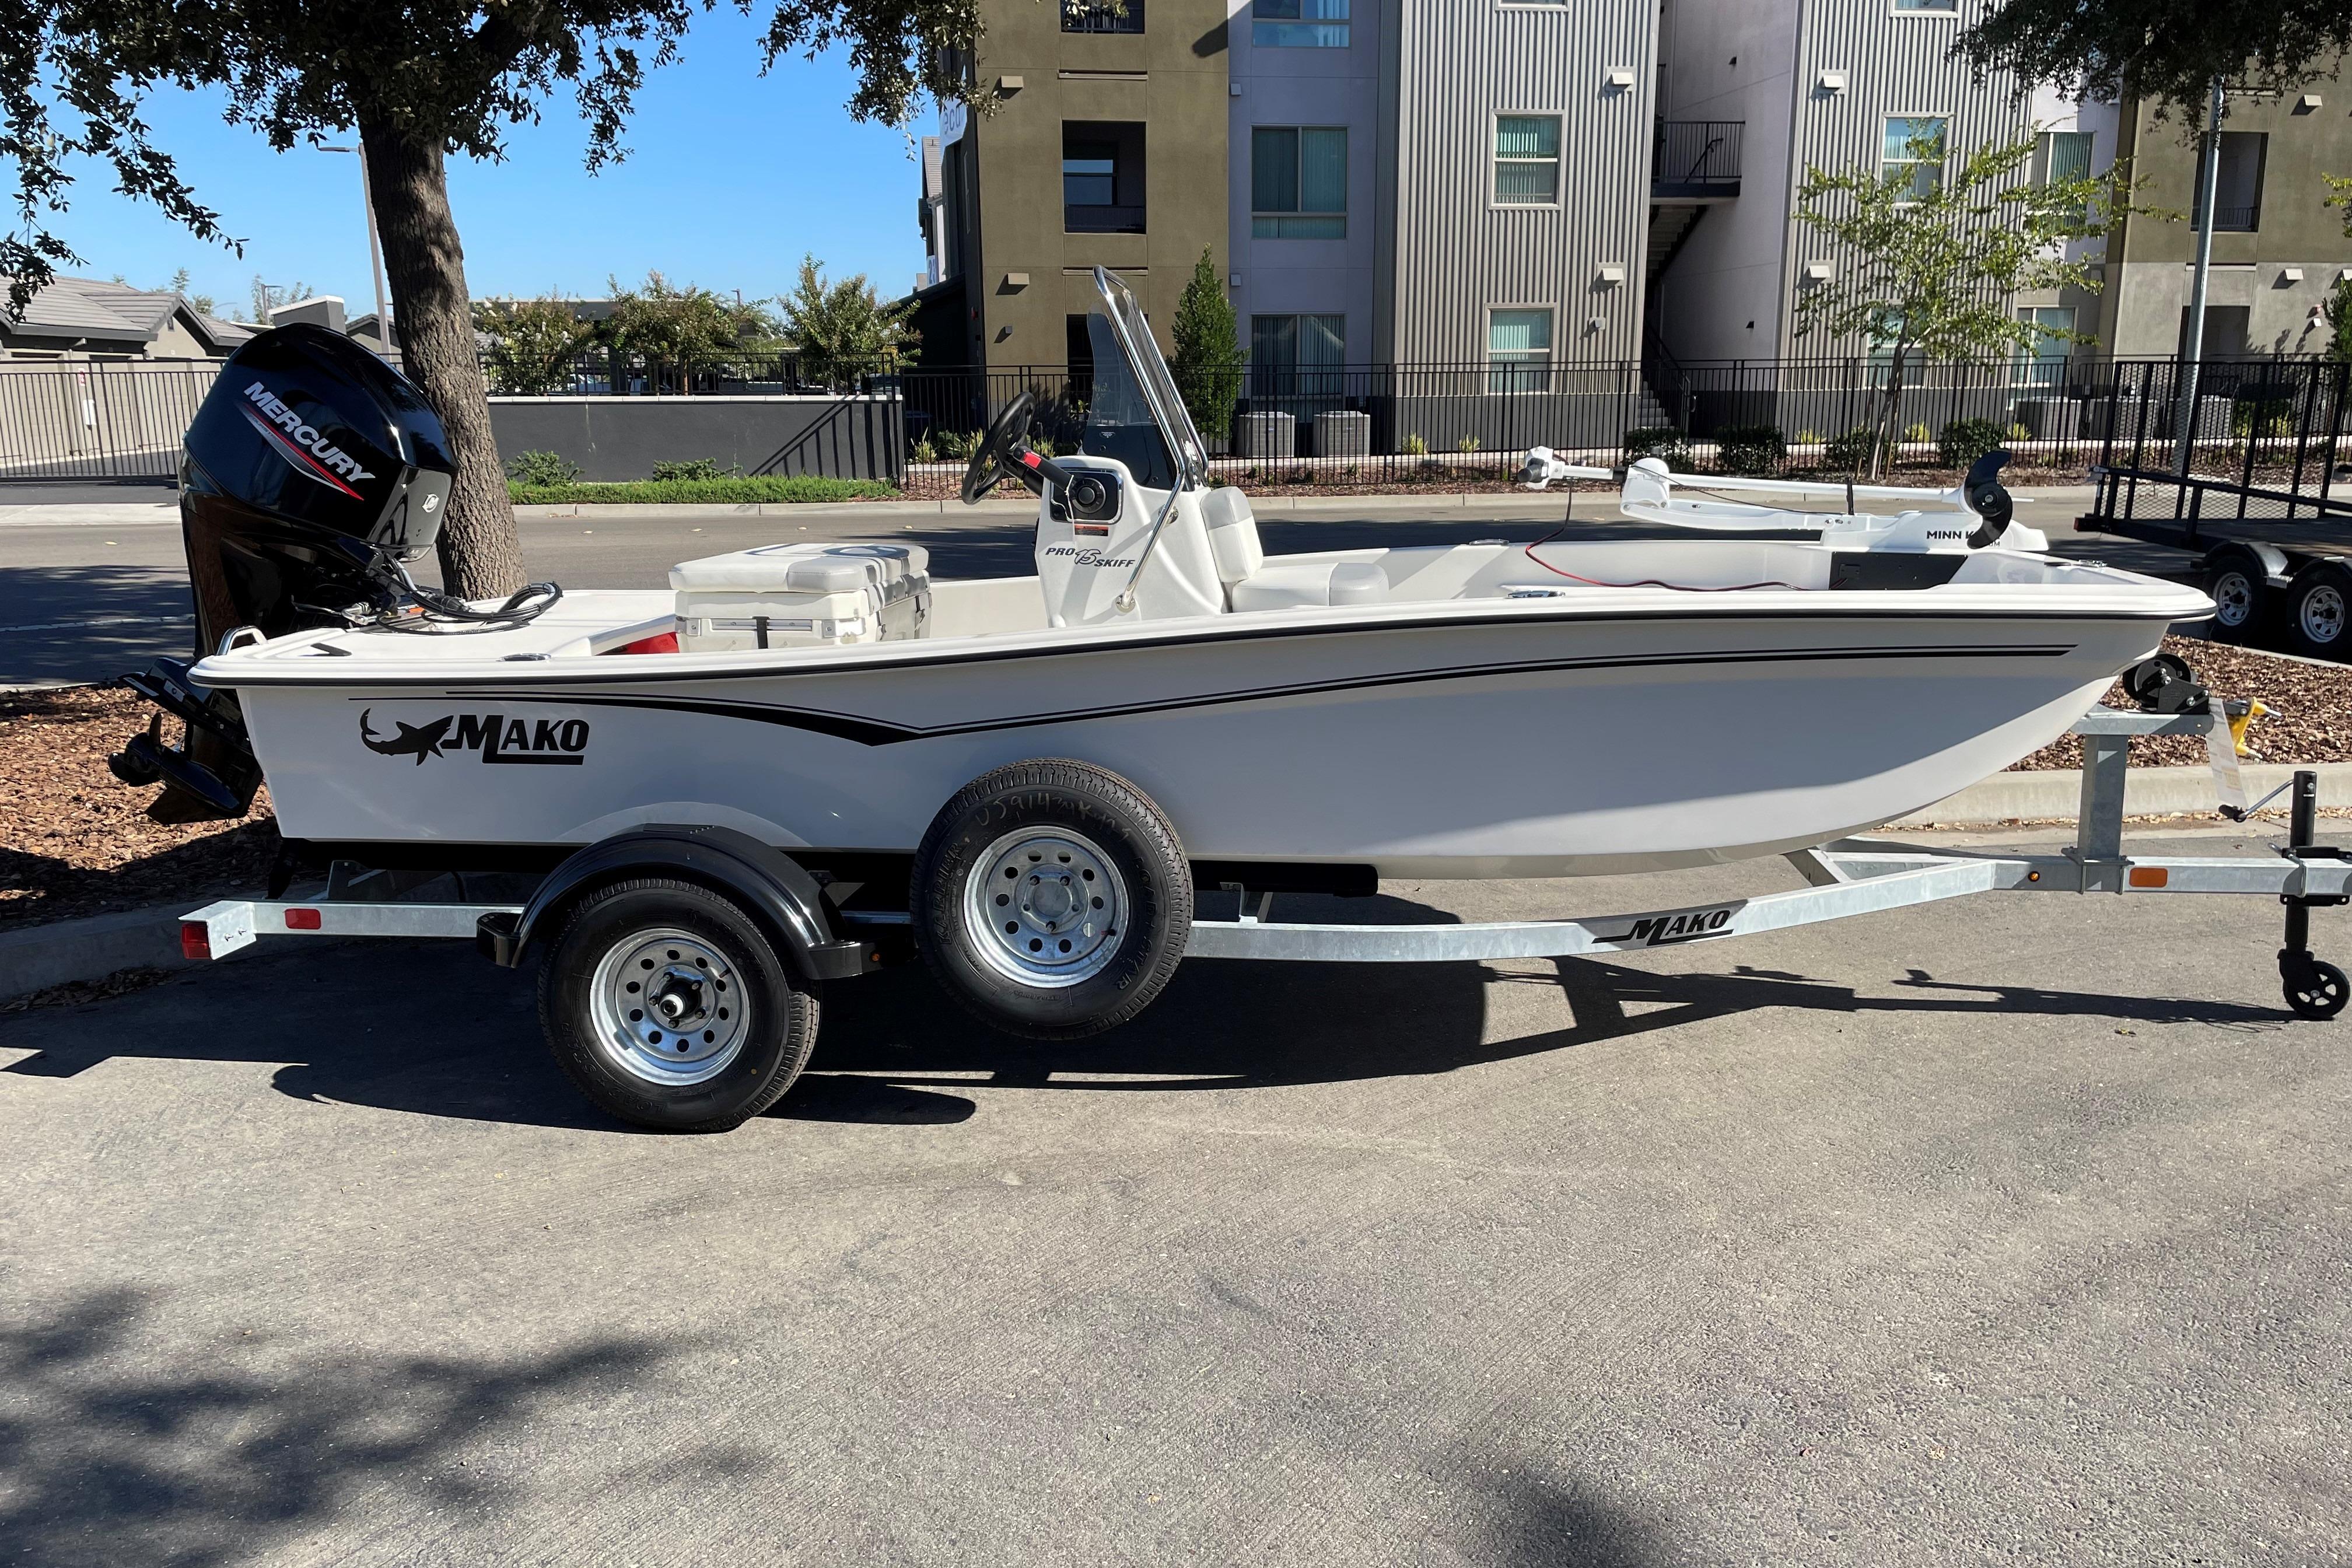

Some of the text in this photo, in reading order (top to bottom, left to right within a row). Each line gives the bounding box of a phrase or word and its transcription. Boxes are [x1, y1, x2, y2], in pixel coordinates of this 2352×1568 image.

[244, 381, 376, 482] MERCURY
[1926, 530, 1962, 539] MINN
[1045, 547, 1076, 555] PRO
[1094, 559, 1136, 567] SKIFF
[440, 715, 590, 765] MAKO
[1591, 909, 1734, 946] MAKO
